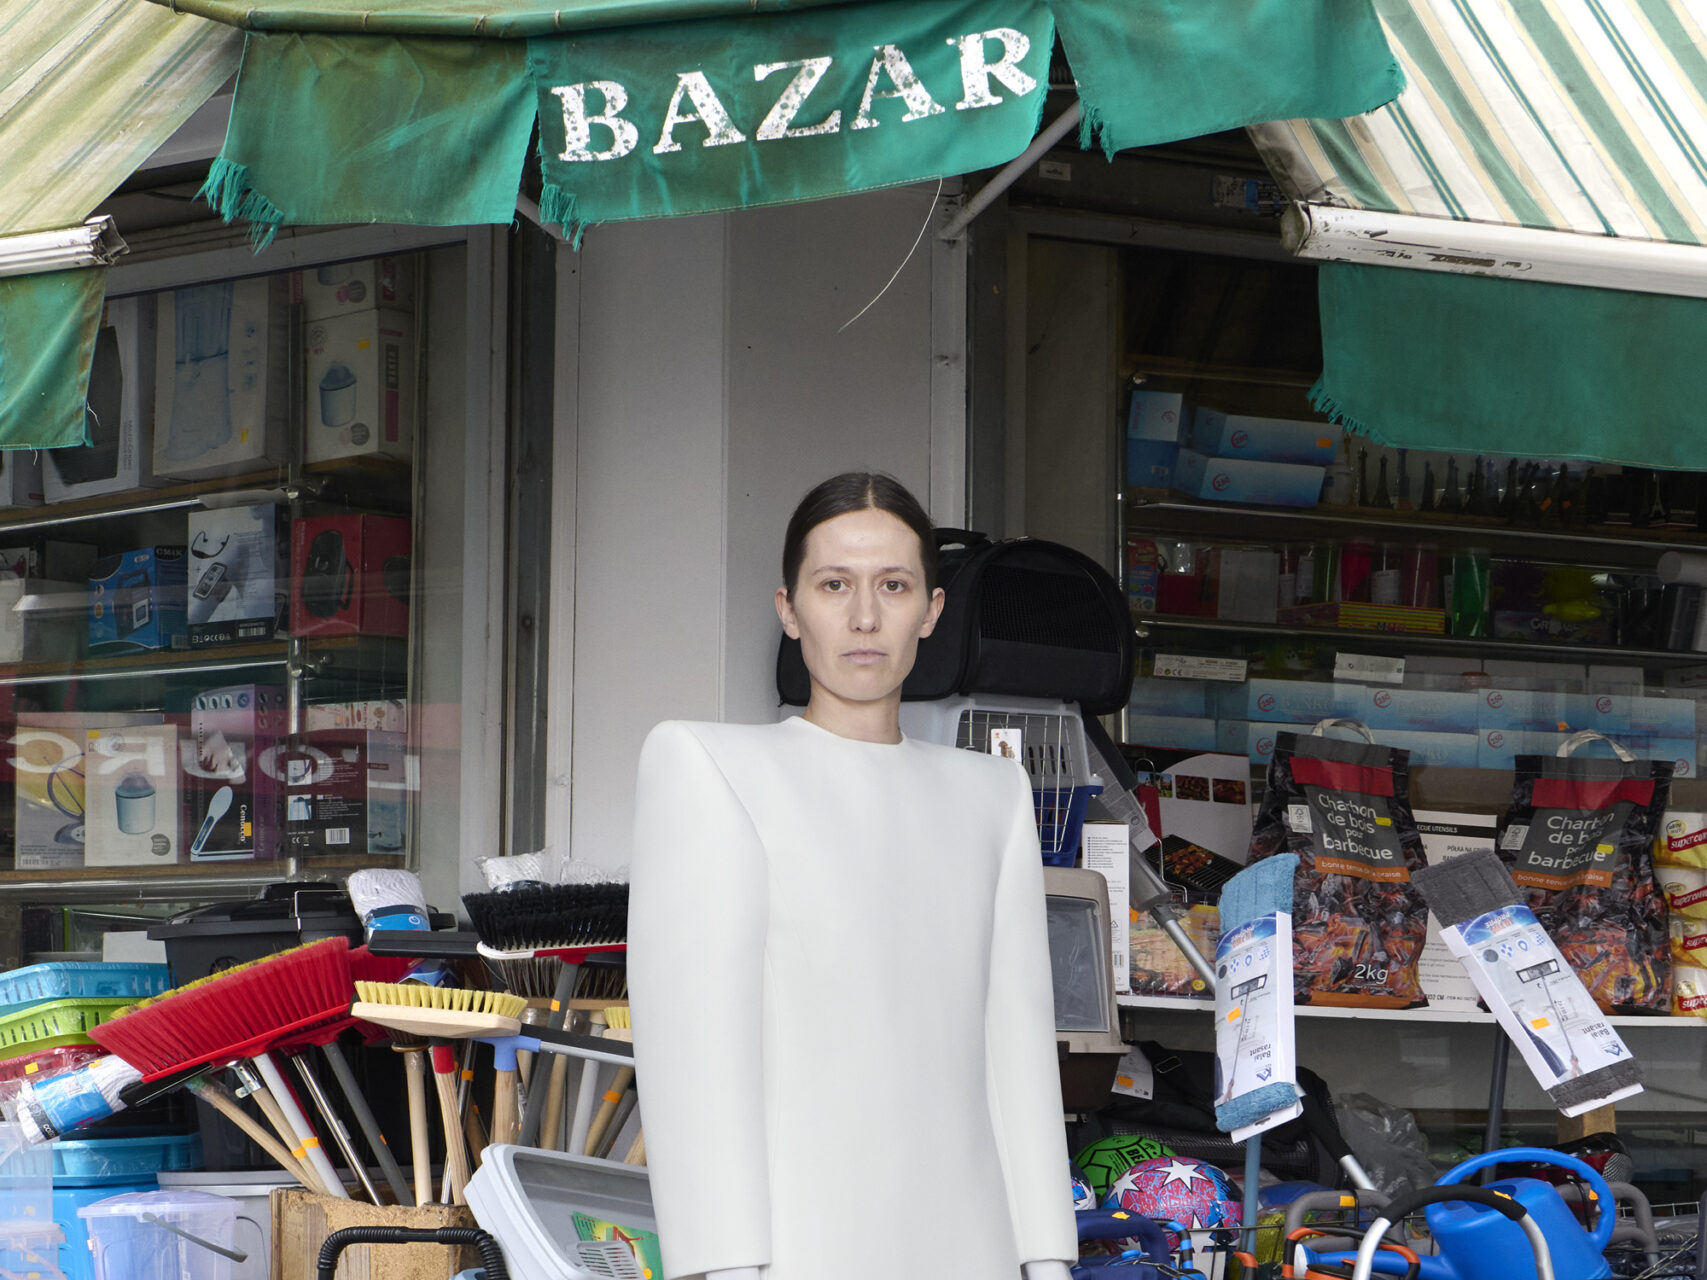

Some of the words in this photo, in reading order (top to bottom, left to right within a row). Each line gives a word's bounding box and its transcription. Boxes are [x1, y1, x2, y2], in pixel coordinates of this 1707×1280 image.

[551, 27, 1038, 163] BAZAR
[1318, 793, 1377, 818] Charbon
[1327, 811, 1346, 826] de
[1348, 813, 1376, 834] bois
[1345, 828, 1364, 839] pour
[1548, 831, 1574, 845] de
[1322, 833, 1394, 860] barbecue
[1527, 850, 1607, 870] barbecue
[1354, 964, 1389, 985] 2kg
[1582, 1021, 1606, 1034] rasant
[1591, 1028, 1612, 1039] Balai
[1249, 1043, 1271, 1056] rasant
[1254, 1050, 1271, 1062] Balai
